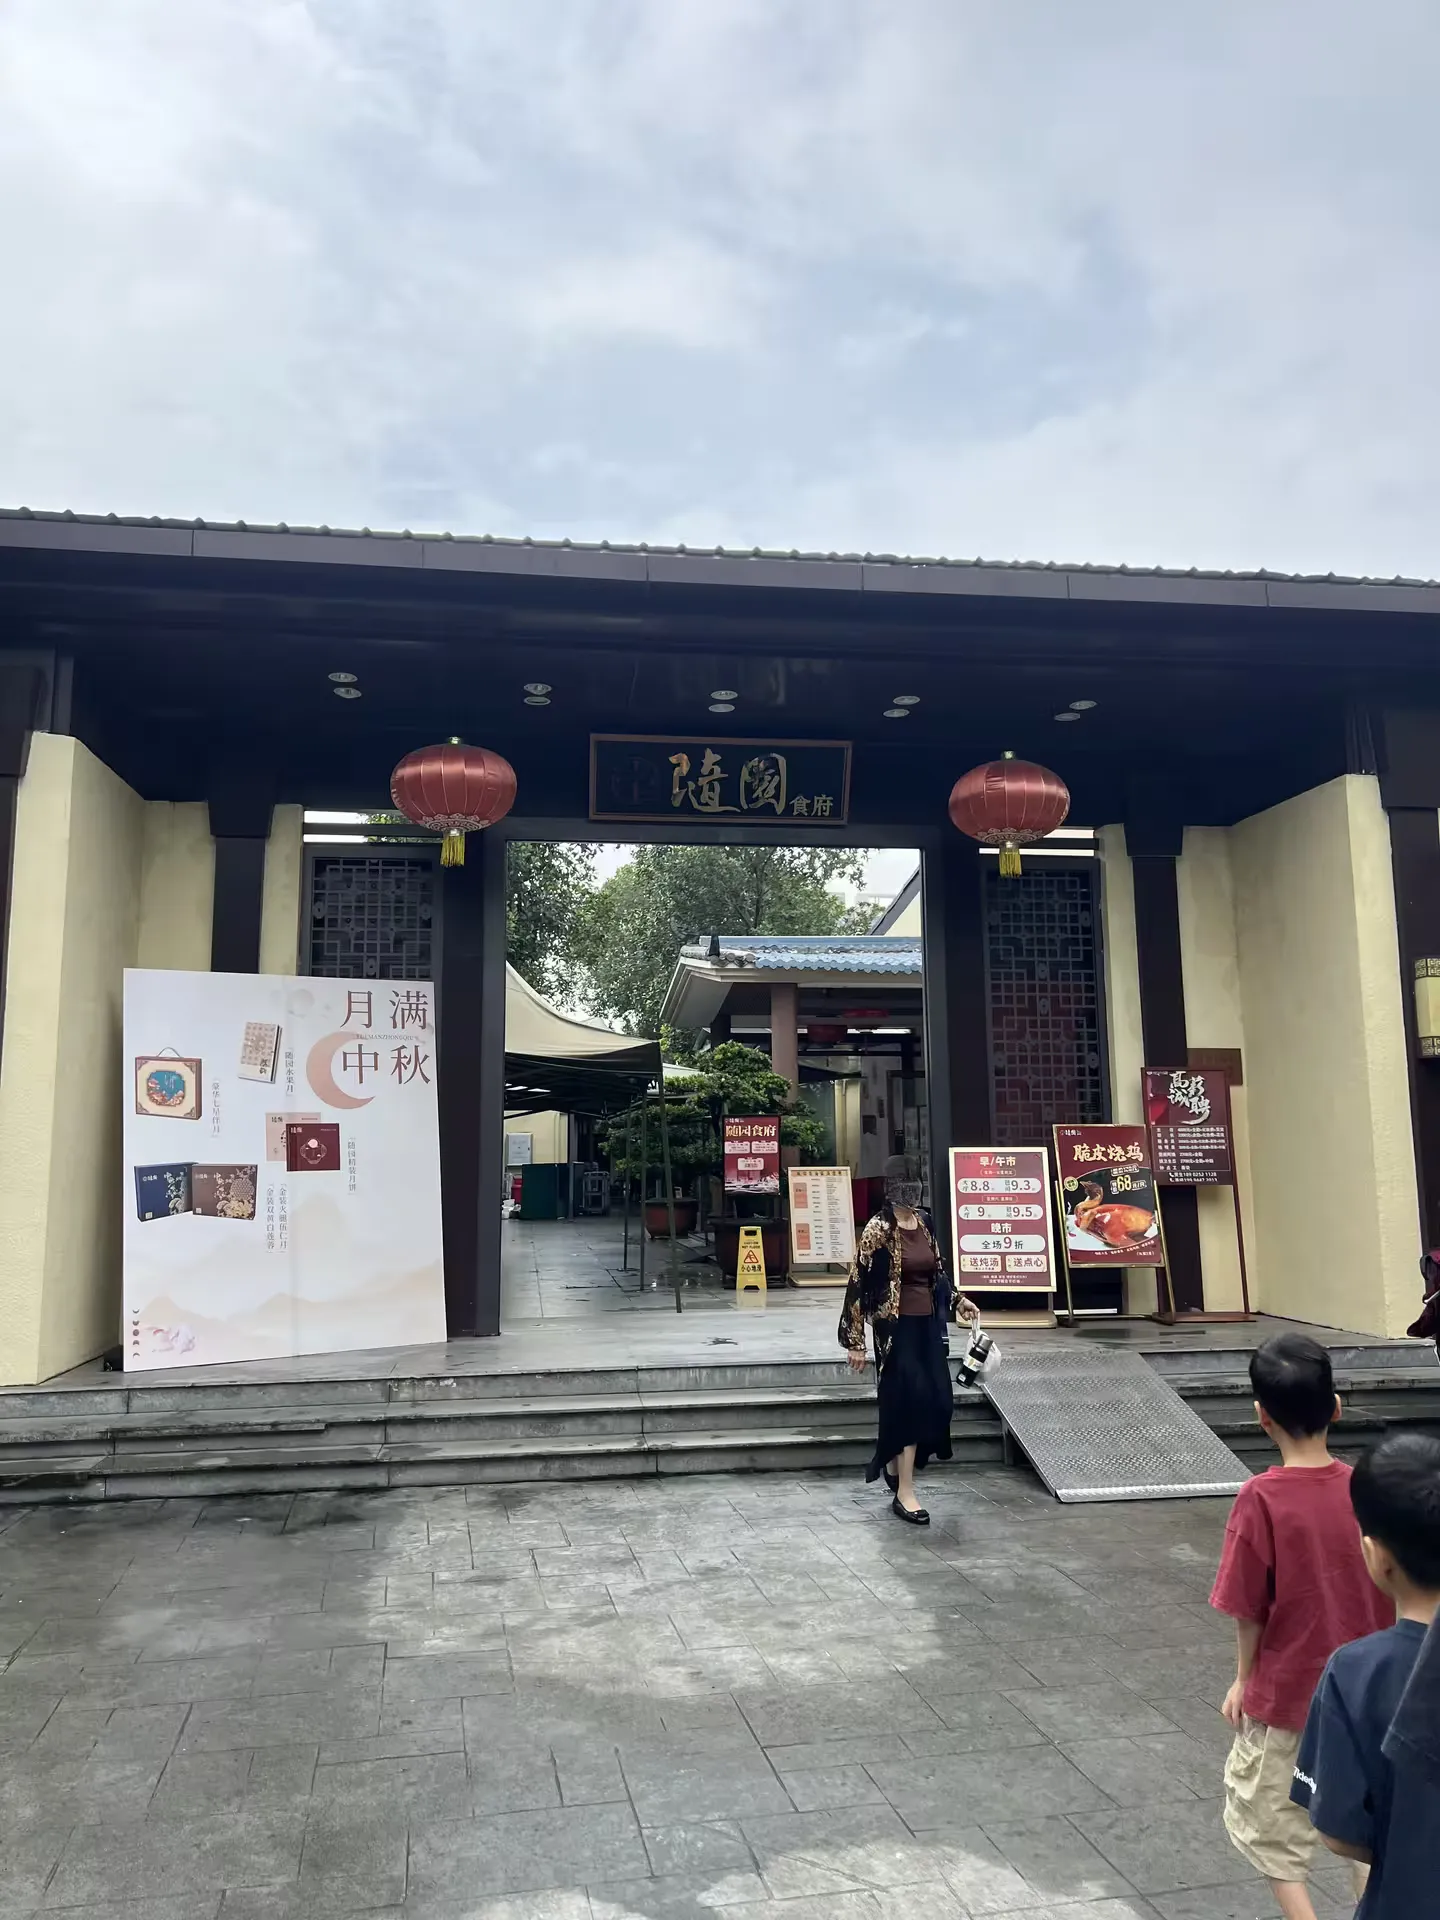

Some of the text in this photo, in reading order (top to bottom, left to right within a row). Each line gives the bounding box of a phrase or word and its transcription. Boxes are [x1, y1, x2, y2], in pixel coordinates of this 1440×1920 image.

[789, 794, 833, 816] 食府
[340, 990, 428, 1029] 月满
[342, 1044, 431, 1084] 中秋
[725, 1124, 777, 1137] 随园食府
[1072, 1141, 1144, 1162] 脆皮烧鸡
[979, 1156, 1017, 1167] 早/午市
[1117, 1174, 1131, 1191] 68
[1013, 1257, 1044, 1267] 送点心
